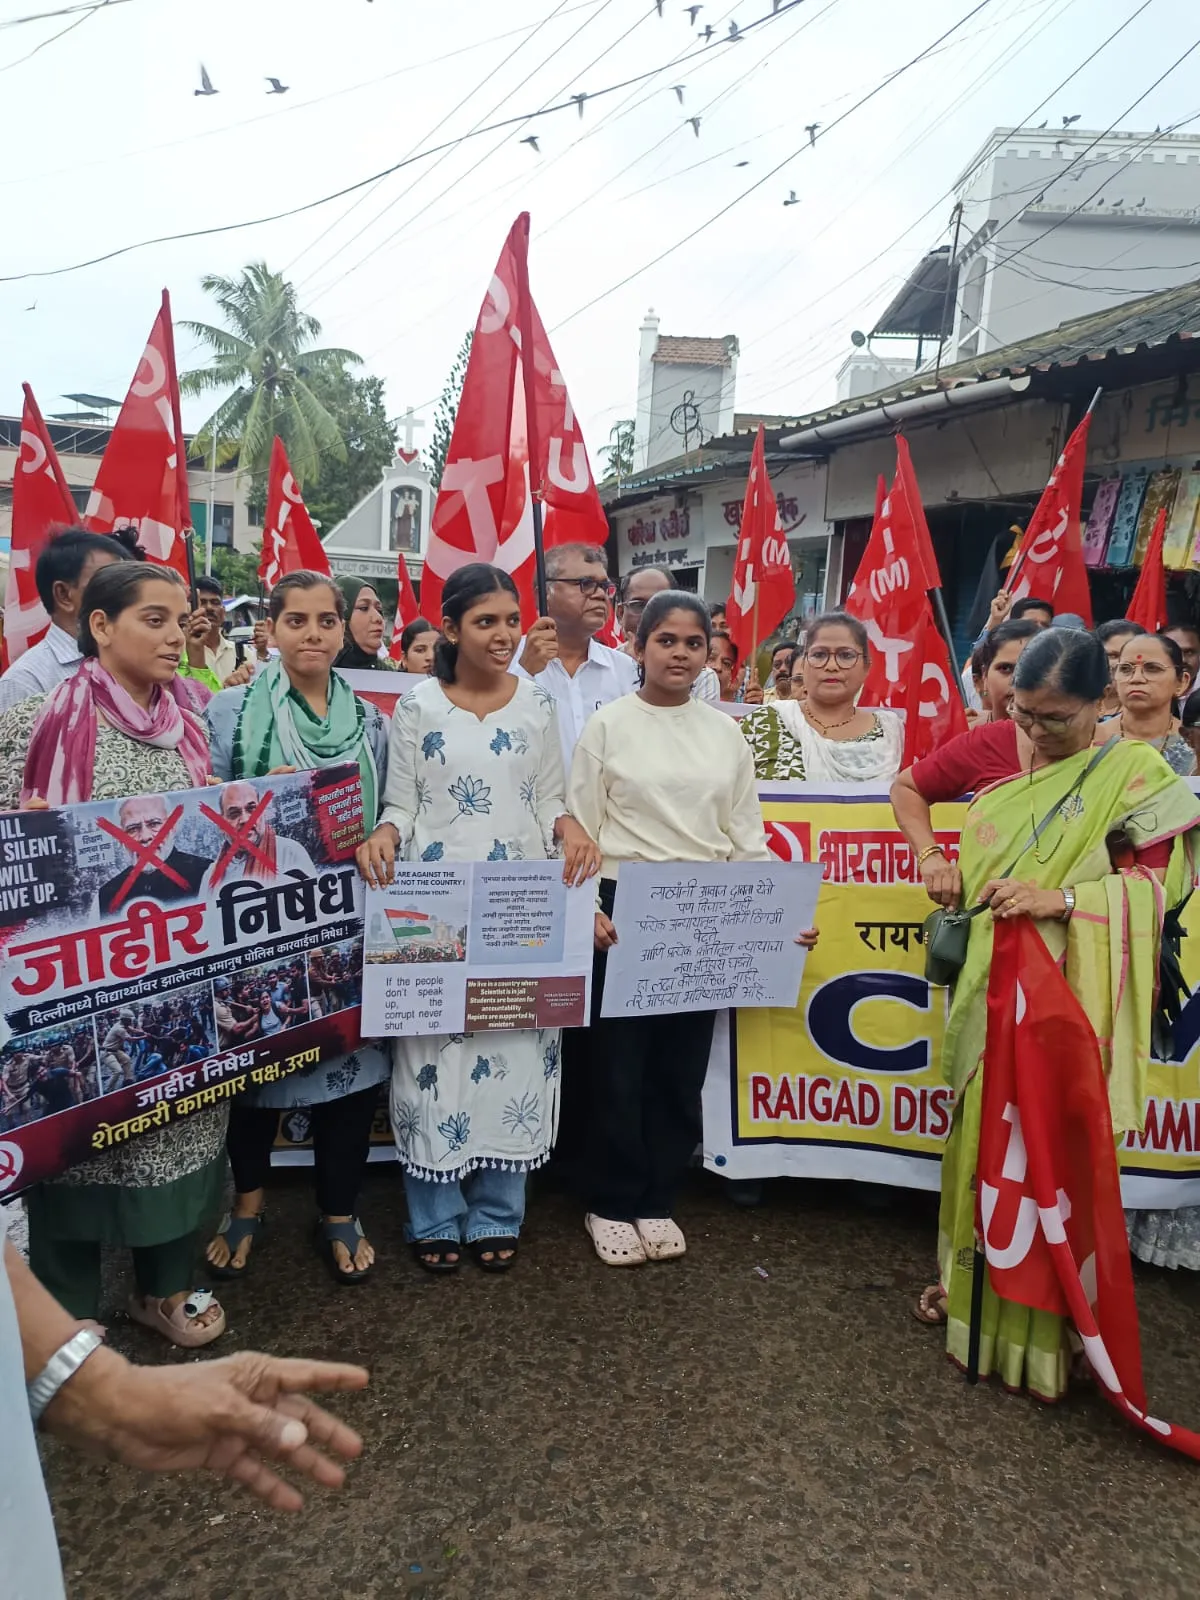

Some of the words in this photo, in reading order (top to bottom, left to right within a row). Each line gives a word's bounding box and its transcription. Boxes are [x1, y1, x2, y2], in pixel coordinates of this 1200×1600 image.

[0, 817, 26, 840] ILL
[4, 835, 62, 862] SILENT.
[818, 831, 924, 884] भारताचा
[0, 862, 39, 887] WILL
[33, 882, 58, 904] UP.
[700, 884, 727, 898] आवाज
[676, 902, 694, 914] पण
[730, 895, 754, 911] नाही
[8, 901, 209, 996] जाहीर
[216, 869, 355, 946] निषेध
[640, 943, 666, 962] आणि
[29, 996, 92, 1026] दिल्लीमध्ये
[161, 964, 204, 988] झालेल्या
[207, 955, 242, 974] अमानुष
[244, 944, 274, 962] पोलिस
[277, 932, 319, 954] कारवाईचा
[321, 926, 343, 943] निषेध
[674, 962, 692, 973] नवा
[386, 977, 392, 986] If
[397, 977, 410, 986] the
[415, 976, 444, 987] people
[498, 980, 520, 988] country
[385, 988, 407, 997] don't
[418, 987, 443, 998] speak
[470, 996, 496, 1004] Students
[385, 1001, 399, 1010] up,
[429, 998, 443, 1007] the
[384, 1010, 415, 1020] corrupt
[418, 1009, 443, 1018] never
[467, 1013, 488, 1021] Rapists
[499, 1013, 528, 1021] supported
[528, 1012, 535, 1021] by
[384, 1021, 403, 1030] shut
[428, 1021, 441, 1031] up.
[136, 1069, 196, 1108] जाहीर
[202, 1048, 255, 1083] निषेध
[752, 1076, 880, 1126] RAIGAD
[92, 1099, 170, 1149] शेतकरी
[175, 1073, 247, 1115] कामगार
